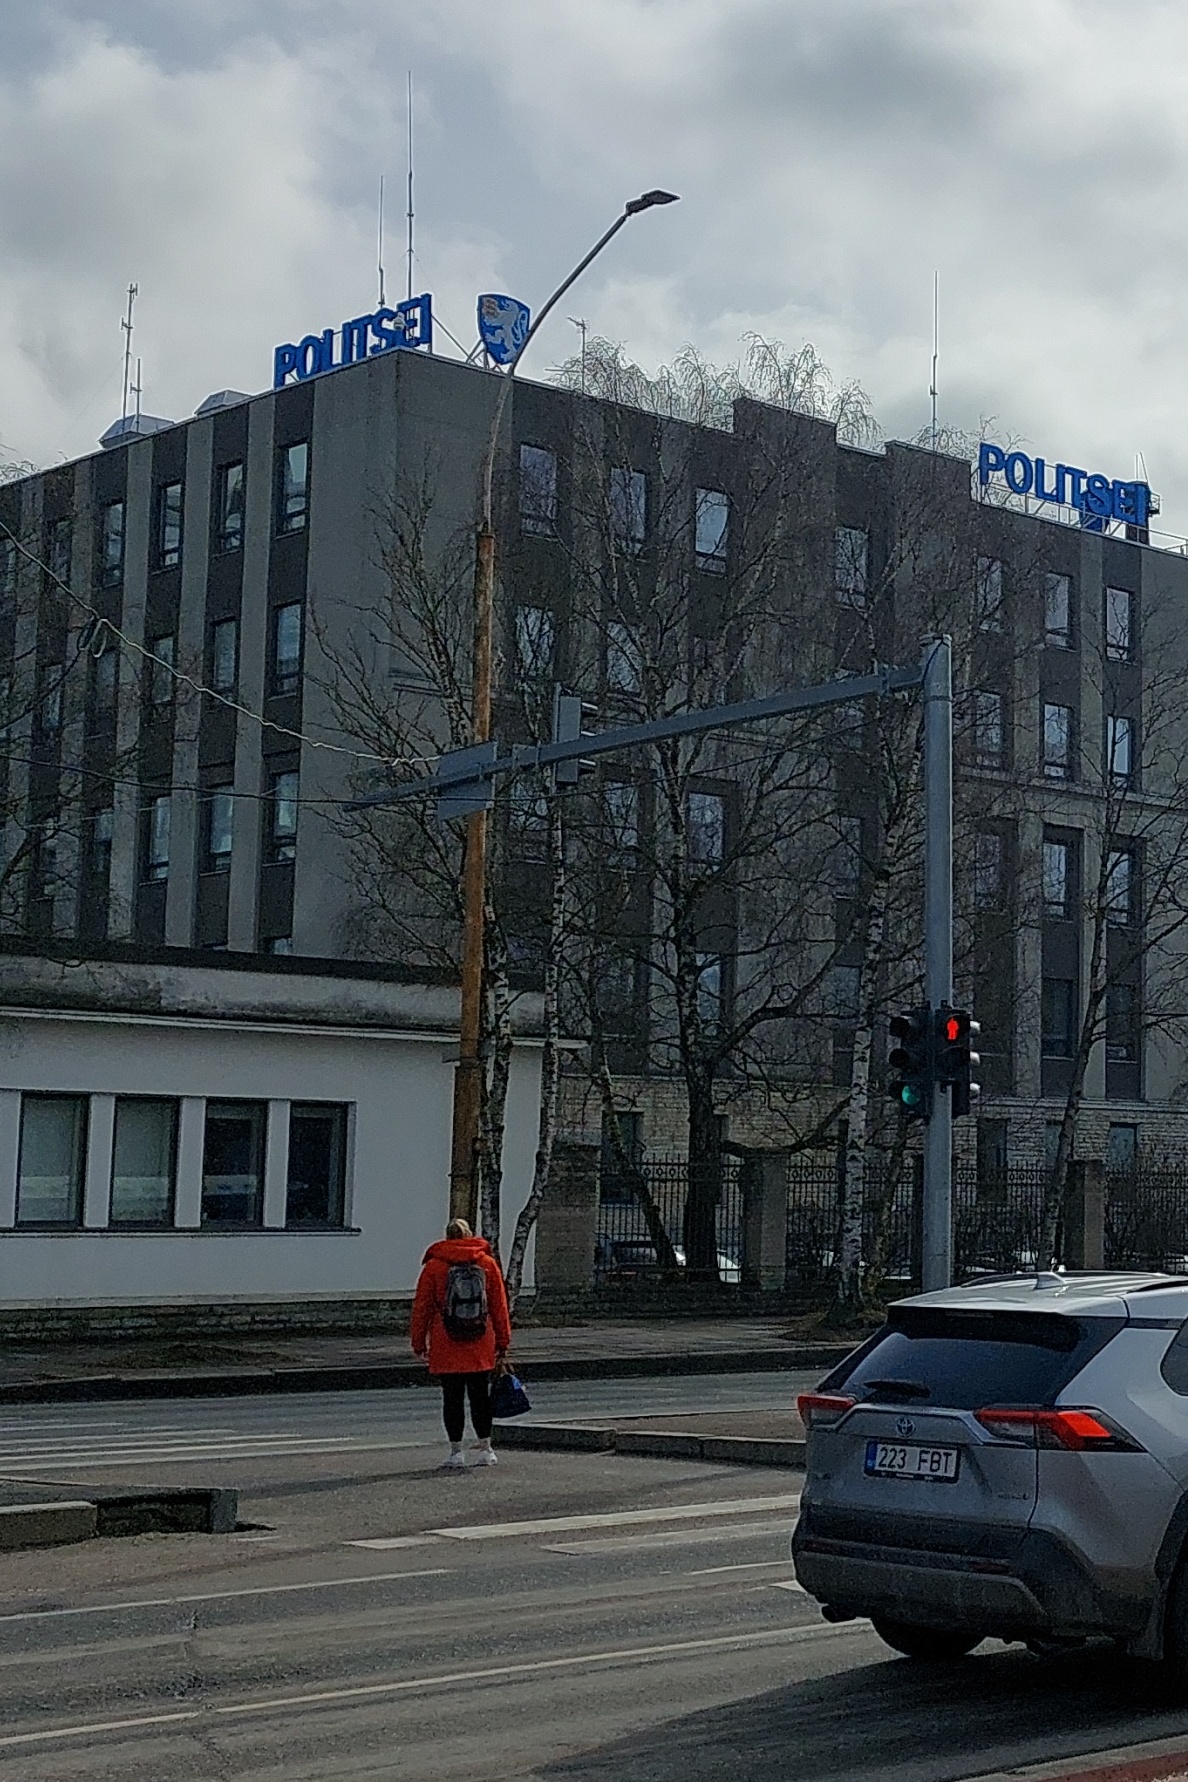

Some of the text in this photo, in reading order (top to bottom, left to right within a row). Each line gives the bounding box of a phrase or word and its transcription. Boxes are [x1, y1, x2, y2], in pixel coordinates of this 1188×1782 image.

[274, 293, 432, 390] POLITSEI
[979, 442, 1149, 527] POLITSEI
[878, 1446, 953, 1475] 223 FBT
